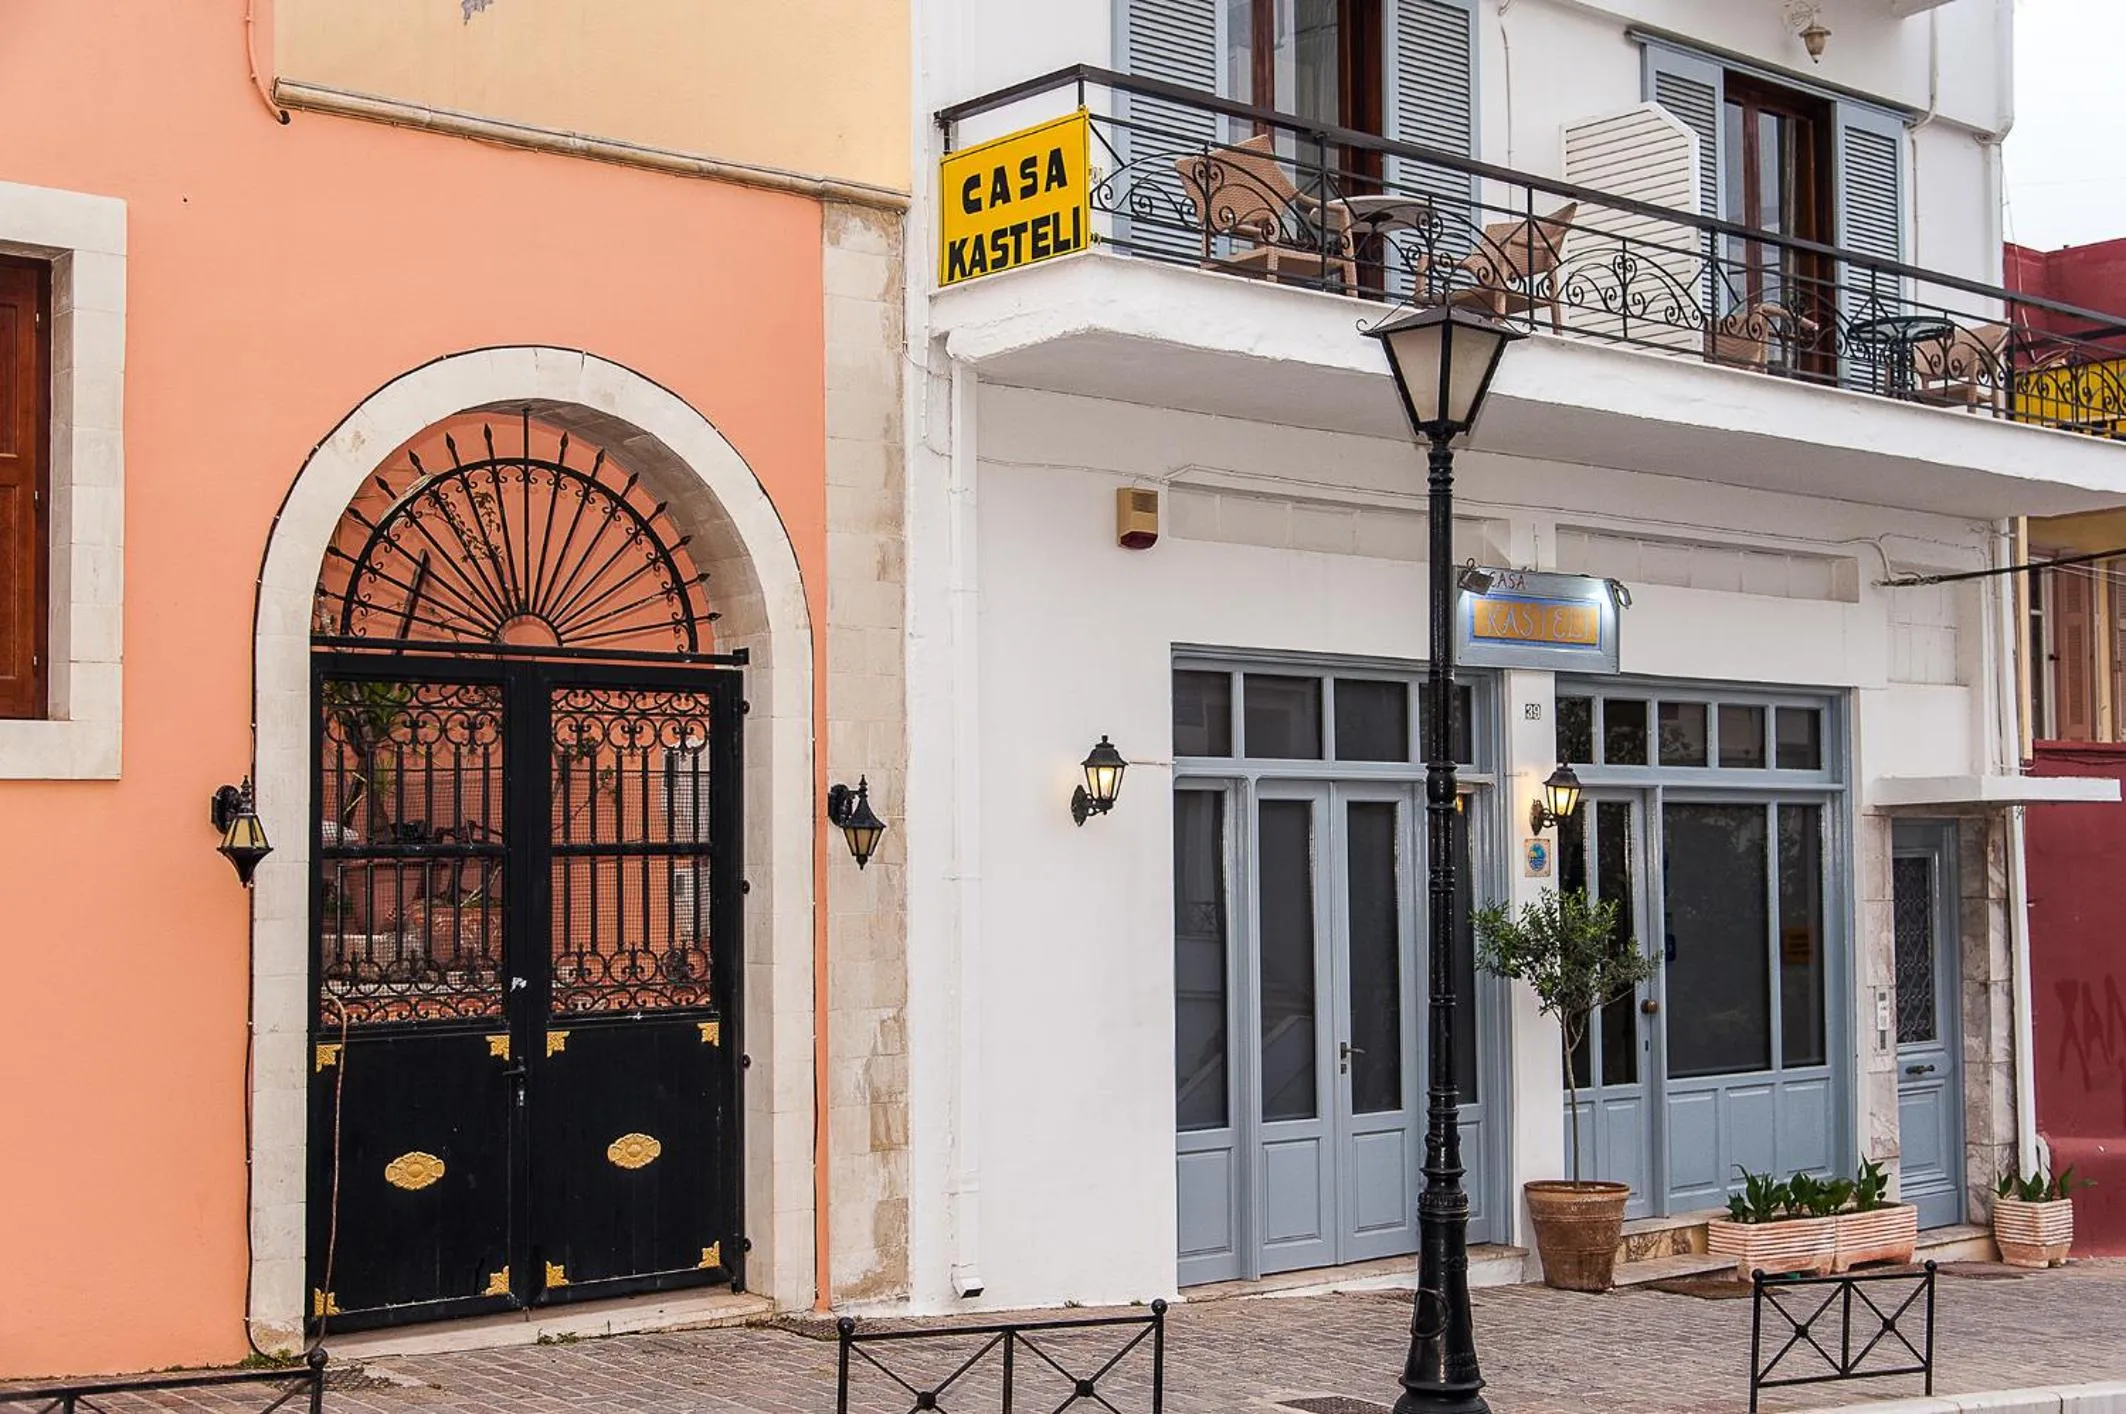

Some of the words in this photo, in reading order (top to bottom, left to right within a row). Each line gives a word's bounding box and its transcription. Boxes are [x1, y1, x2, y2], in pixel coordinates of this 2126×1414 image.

[962, 147, 1068, 215] CASA
[947, 205, 1081, 282] KASTELI
[1489, 570, 1527, 590] CASA
[1487, 602, 1590, 640] KASTELI
[1525, 703, 1542, 720] 39
